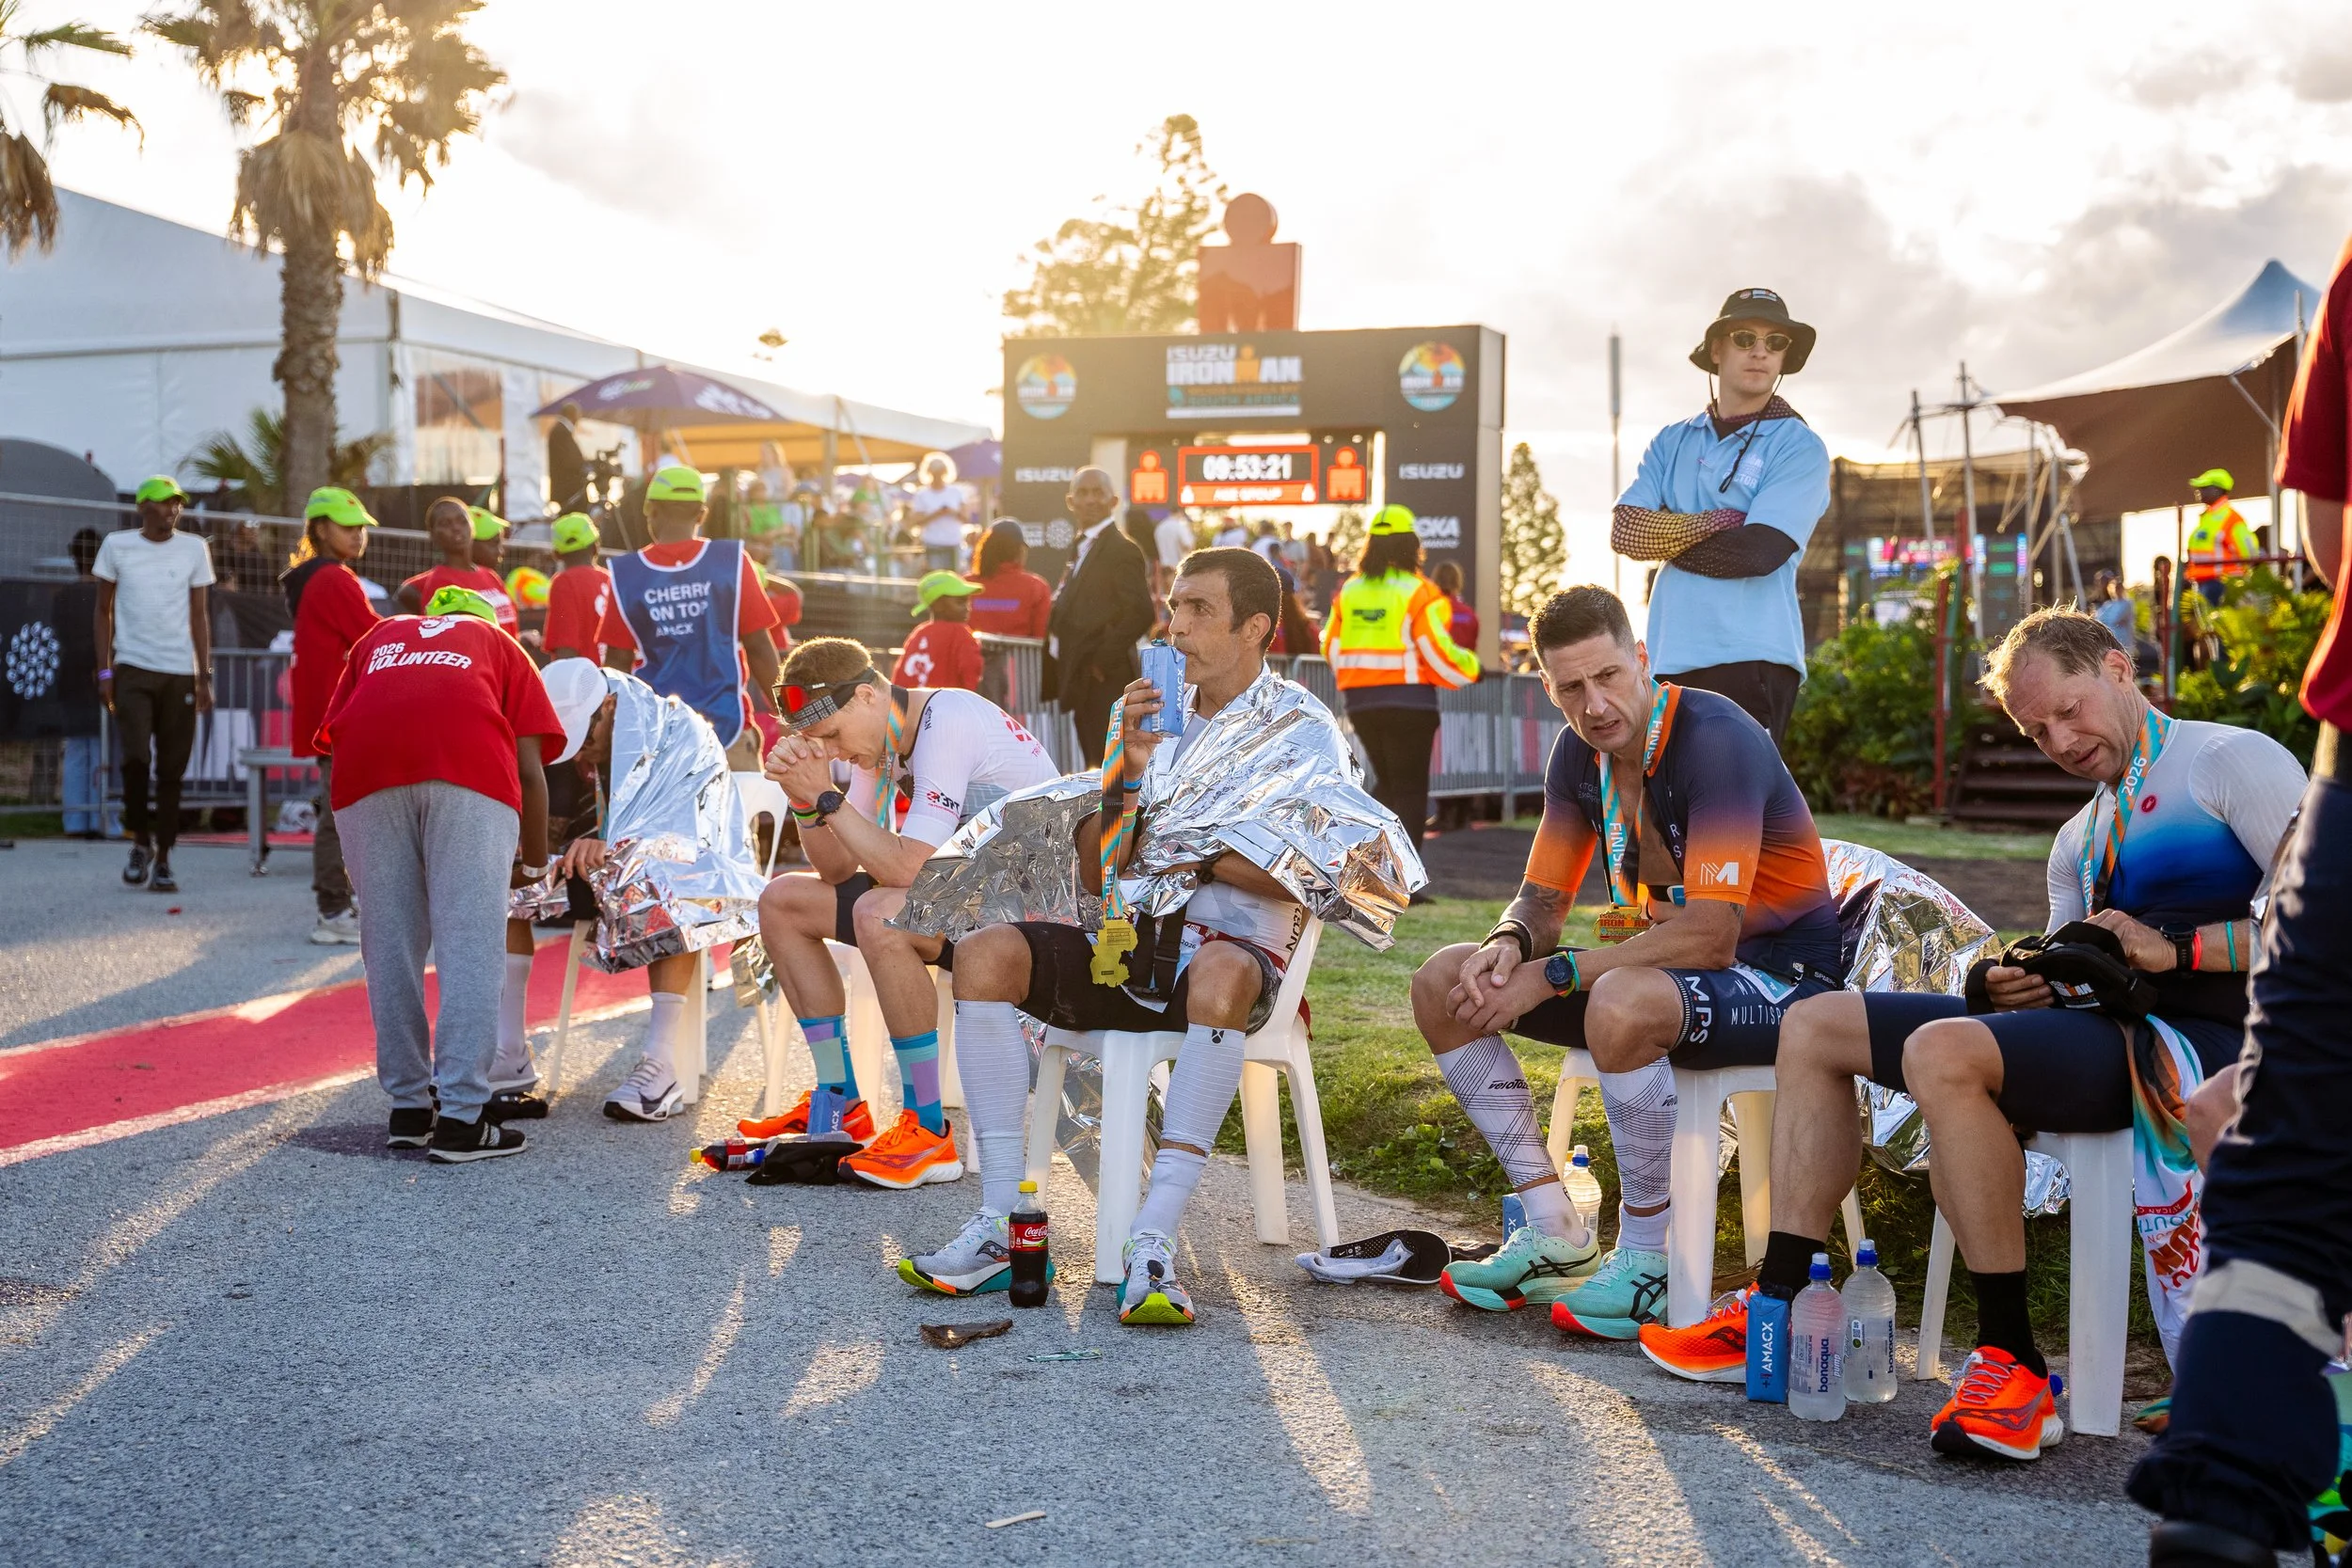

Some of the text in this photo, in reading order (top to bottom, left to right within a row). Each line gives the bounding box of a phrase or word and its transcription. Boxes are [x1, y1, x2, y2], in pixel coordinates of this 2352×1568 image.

[1167, 344, 1236, 362] ISUZU
[1015, 467, 1076, 483] ISUZU
[1398, 463, 1465, 480] ISUZU
[1416, 515, 1460, 538] OKA
[644, 580, 712, 604] CHERRY
[649, 604, 675, 622] ON
[367, 650, 472, 674] VOLUNTEER
[372, 641, 406, 660] 2026
[1175, 668, 1184, 710] AMACX
[1110, 701, 1124, 741] SHER
[1645, 720, 1663, 769] FINIS
[2122, 756, 2148, 797] 2026
[1610, 822, 1625, 884] FINIS
[1181, 939, 1197, 950] 2026
[831, 1110, 840, 1133] ACX
[1761, 1321, 1773, 1372] AMACX
[1818, 1338, 1831, 1393] bonaqua
